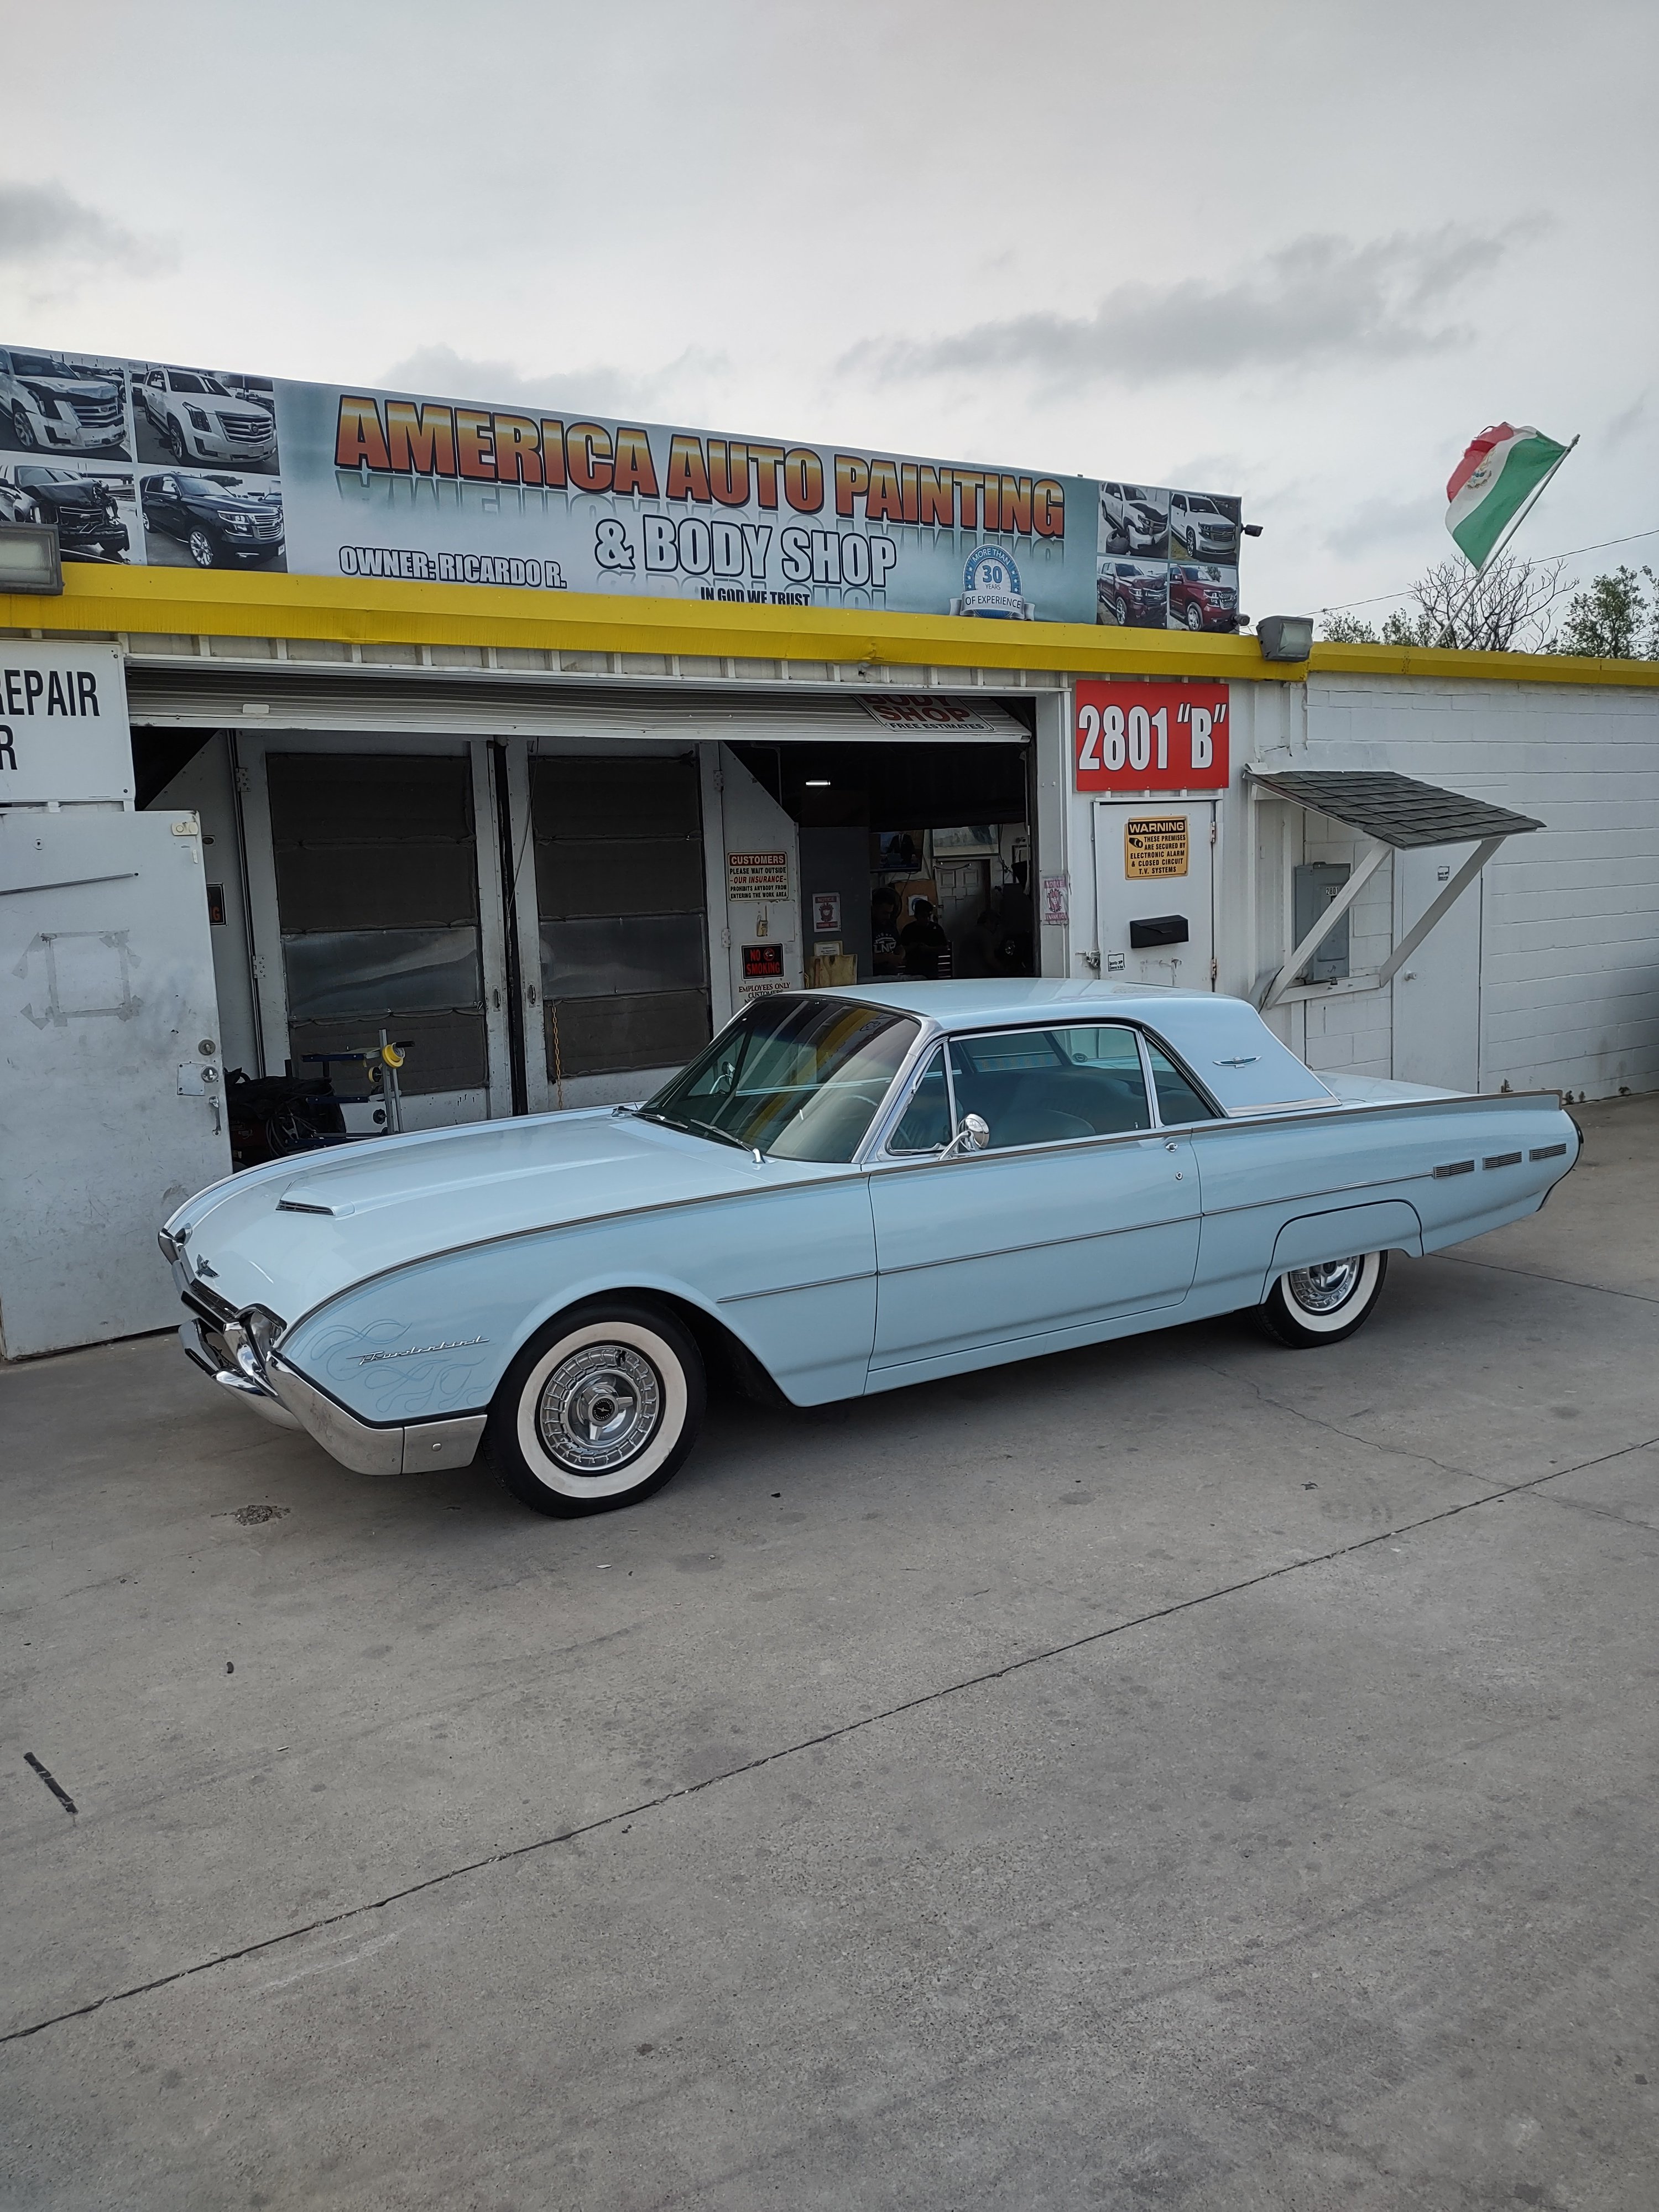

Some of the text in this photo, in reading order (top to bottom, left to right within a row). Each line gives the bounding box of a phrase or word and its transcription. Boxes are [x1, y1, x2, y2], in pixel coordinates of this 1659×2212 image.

[335, 394, 1065, 539] AMERICA AUTO PAINTING
[594, 514, 896, 588] & BODY SHOP
[972, 548, 1010, 565] MORE THAN
[338, 545, 567, 589] OWNER: RICARDO R.
[982, 565, 1003, 583] 30
[701, 586, 810, 606] IN GOD WE TRUST
[966, 596, 1022, 608] OF EXPERIENCE
[0, 670, 100, 717] EPAIR
[873, 705, 971, 722] SHOP
[1078, 703, 1168, 771] 2801
[1129, 822, 1184, 833] WARNING
[731, 855, 784, 865] CUSTOMERS
[1326, 887, 1339, 895] 2801
[750, 950, 761, 961] NO
[747, 962, 780, 975] SMOKING
[739, 984, 773, 993] EMPLOYEES
[346, 1335, 489, 1366] Thunderbird
